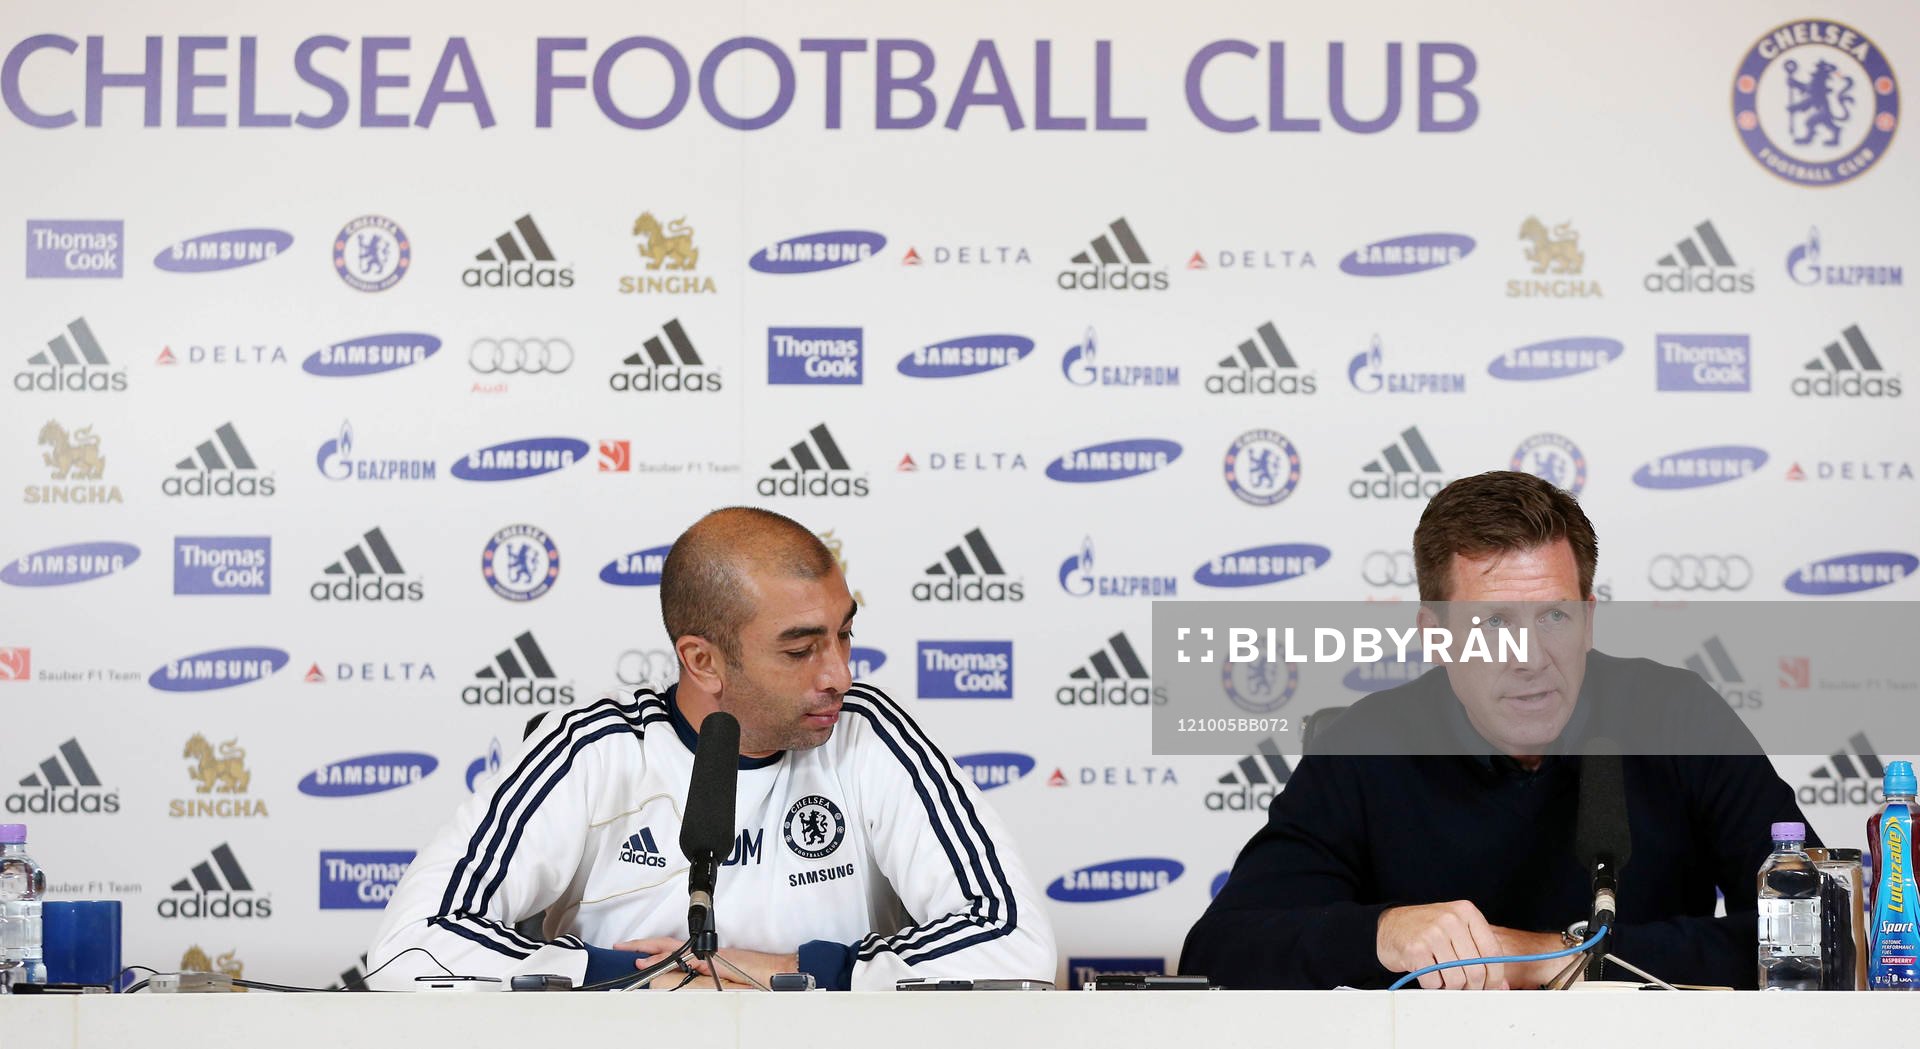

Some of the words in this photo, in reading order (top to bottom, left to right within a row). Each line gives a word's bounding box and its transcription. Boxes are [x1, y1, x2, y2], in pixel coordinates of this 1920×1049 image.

[1757, 22, 1870, 61] CHELSEA
[0, 33, 497, 130] CHELSEA
[534, 35, 1148, 132] FOOTBALL
[1184, 39, 1481, 135] CLUB
[1758, 147, 1833, 181] FOOTBALL
[1836, 147, 1875, 177] CLUB
[32, 229, 119, 252] Thomas
[65, 251, 118, 272] Cook
[172, 241, 279, 263] SAMSUNG
[765, 242, 872, 262] SAMSUNG
[934, 246, 1032, 265] DELTA
[1219, 250, 1316, 269] DELTA
[1355, 245, 1462, 265] SAMSUNG
[462, 261, 575, 290] adidas
[619, 276, 718, 295] SINGHA
[1057, 266, 1169, 291] adidas
[1644, 268, 1754, 294] adidas
[1825, 266, 1903, 286] GAZPROM
[1506, 280, 1603, 298] SINGHA
[189, 345, 288, 364] DELTA
[319, 343, 426, 366] SAMSUNG
[773, 334, 858, 357] Thomas
[913, 345, 1019, 367] SAMSUNG
[1661, 342, 1746, 364] Thomas
[805, 356, 858, 378] Cook
[1503, 347, 1609, 368] SAMSUNG
[13, 365, 128, 393] adidas
[610, 365, 722, 393] adidas
[1102, 366, 1180, 387] GAZPROM
[1205, 369, 1317, 395] adidas
[1387, 373, 1466, 393] GAZPROM
[1693, 362, 1745, 384] Cook
[471, 382, 509, 394] Audi
[1791, 371, 1902, 398] adidas
[357, 460, 437, 481] GAZPROM
[467, 449, 575, 470] SAMSUNG
[929, 453, 1027, 470] DELTA
[1061, 451, 1168, 471] SAMSUNG
[1646, 458, 1754, 479] SAMSUNG
[162, 468, 276, 497] adidas
[757, 468, 870, 497] adidas
[1817, 462, 1914, 481] DELTA
[23, 485, 124, 505] SINGHA
[1349, 474, 1451, 499] adida
[17, 554, 124, 576] SAMSUNG
[180, 544, 266, 567] Thomas
[1209, 556, 1317, 577] SAMSUNG
[211, 566, 264, 589] Cook
[1799, 563, 1907, 584] SAMSUNG
[310, 573, 424, 602] adidas
[912, 573, 1024, 602] adidas
[1099, 576, 1178, 597] GAZPROM
[166, 658, 274, 680] SAMSUNG
[337, 662, 437, 681] DELTA
[923, 649, 1009, 672] Thomas
[462, 676, 575, 706] adidas
[955, 670, 1008, 694] Cook
[1056, 677, 1169, 706] adidas
[315, 763, 423, 785] SAMSUNG
[1080, 766, 1178, 785] DELTA
[6, 785, 120, 814] adidas
[1205, 784, 1277, 811] adid
[1798, 780, 1884, 806] adida
[169, 798, 269, 818] SINGHA
[790, 795, 831, 815] CHELSEA
[793, 846, 825, 860] FOOTBALL
[824, 841, 839, 856] CLUB
[788, 863, 855, 888] SAMSUNG
[1062, 870, 1171, 892] SAMSUNG
[1888, 830, 1904, 914] Lucozade
[44, 881, 84, 894] auber
[356, 880, 397, 903] Coo
[158, 891, 272, 919] adidas
[1881, 920, 1914, 935] Sport
